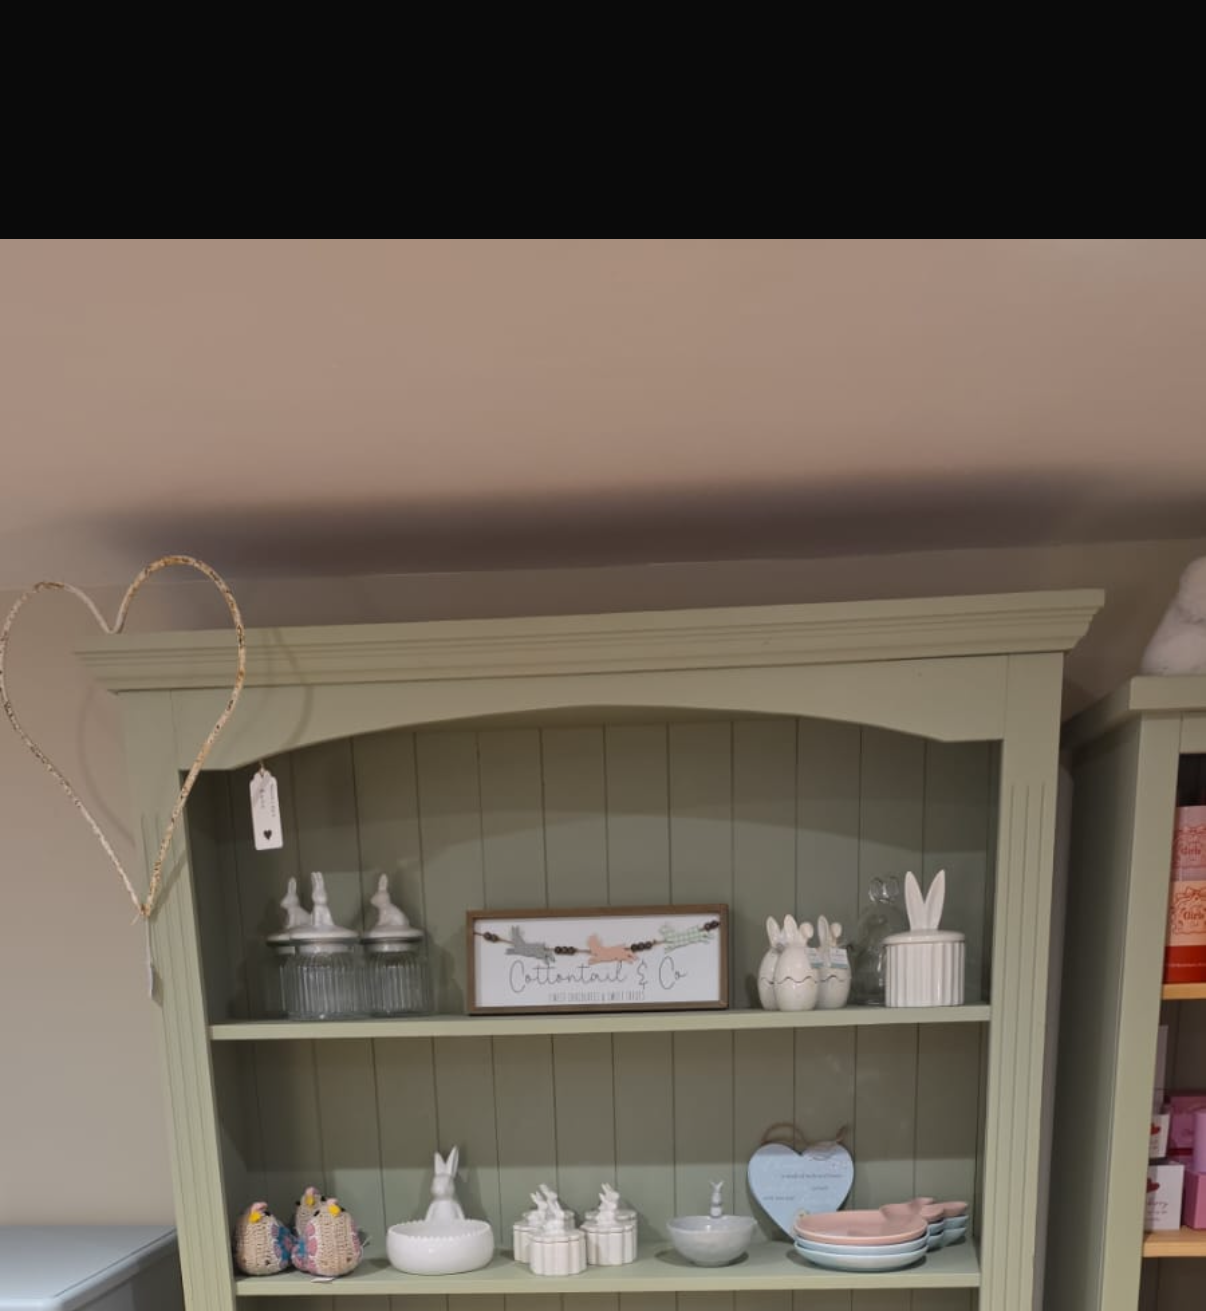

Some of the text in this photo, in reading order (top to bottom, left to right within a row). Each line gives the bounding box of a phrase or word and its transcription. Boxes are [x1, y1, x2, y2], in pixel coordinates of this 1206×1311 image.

[509, 955, 687, 993] Cottontail & Co
